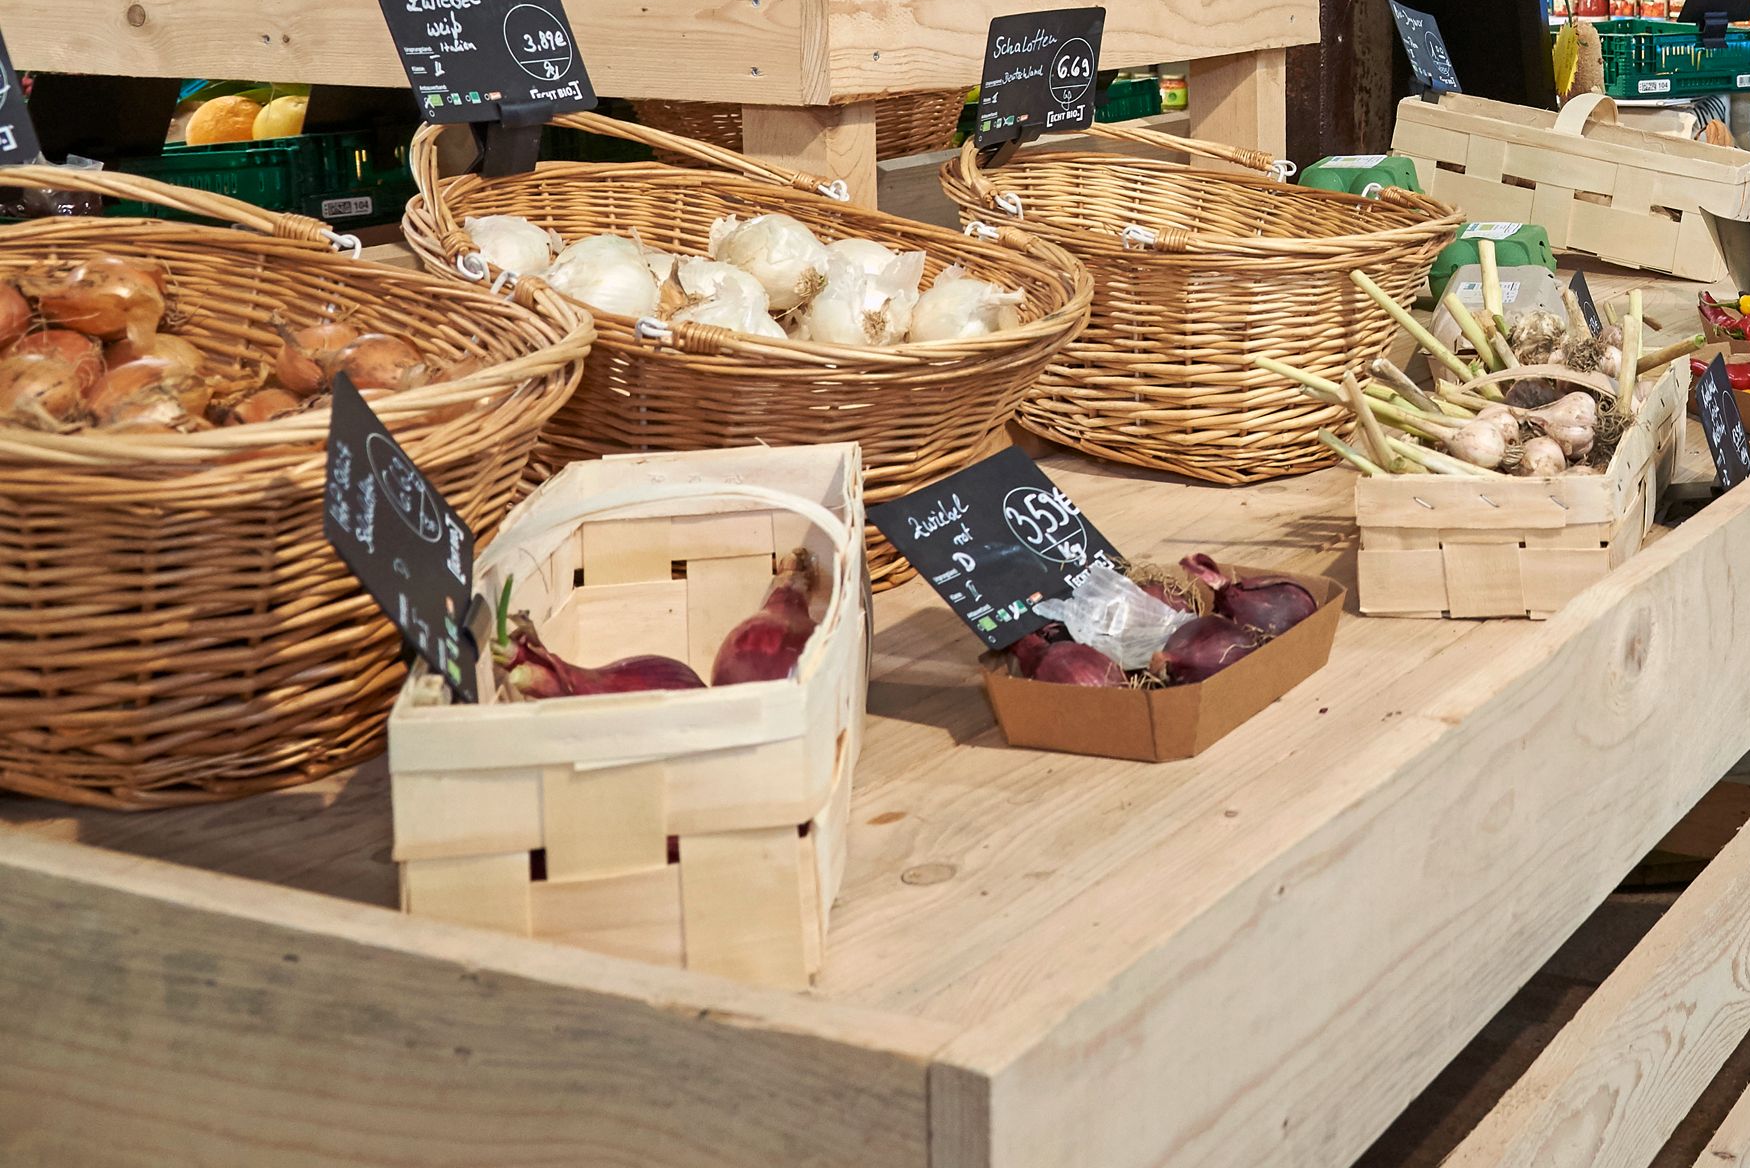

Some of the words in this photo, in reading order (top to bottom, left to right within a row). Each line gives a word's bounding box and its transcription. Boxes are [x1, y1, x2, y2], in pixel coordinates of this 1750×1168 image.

[993, 29, 1058, 59] Schalotten
[354, 200, 369, 210] 104
[908, 493, 969, 540] Zwiebel
[952, 551, 976, 572] D
